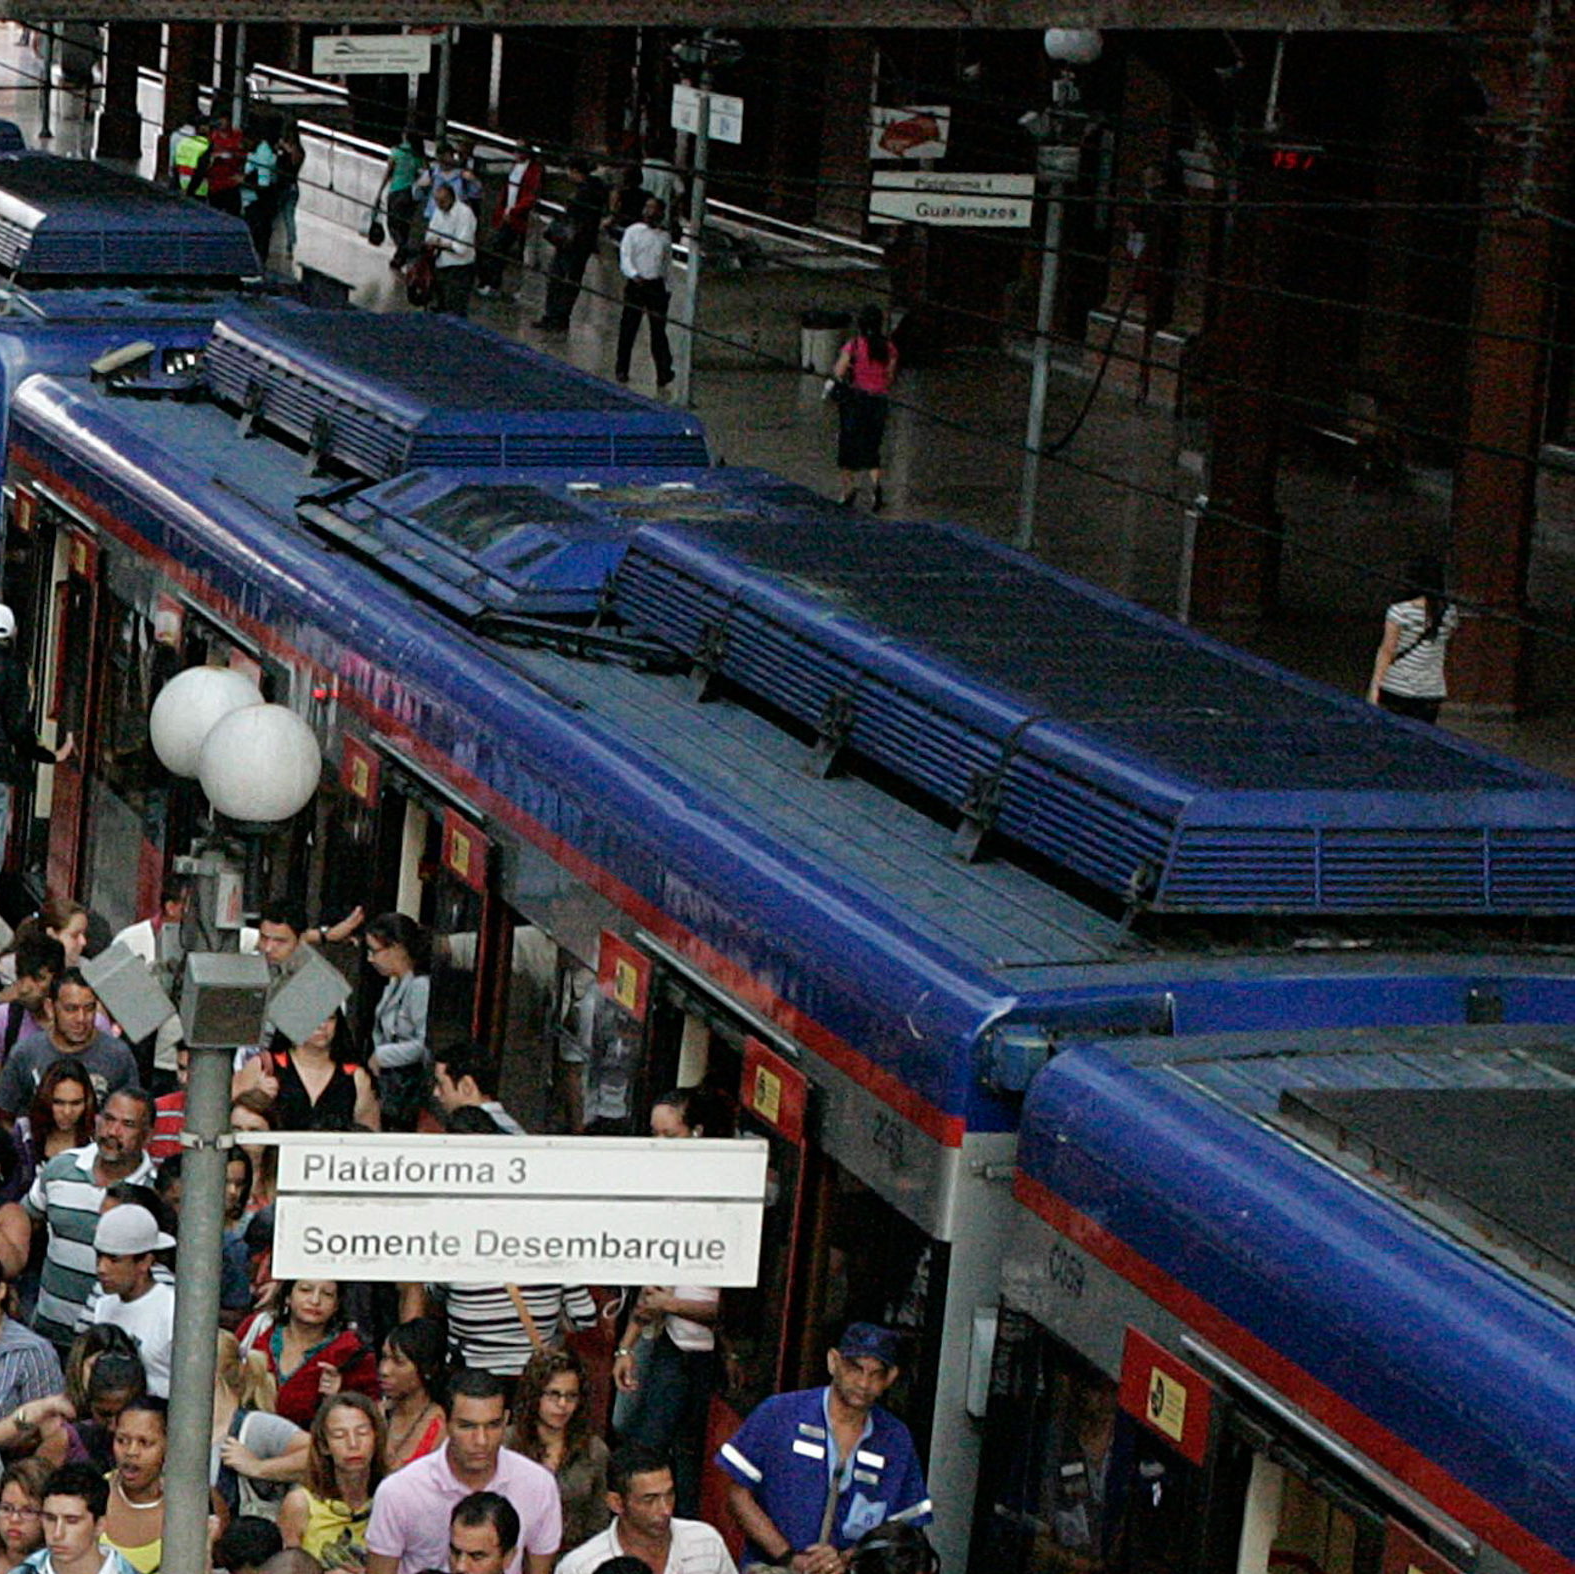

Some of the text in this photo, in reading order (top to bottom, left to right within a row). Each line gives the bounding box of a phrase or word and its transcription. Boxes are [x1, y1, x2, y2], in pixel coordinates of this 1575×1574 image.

[303, 1154, 528, 1184] Plataforma 3
[302, 1226, 726, 1268] Somente Desembarque
